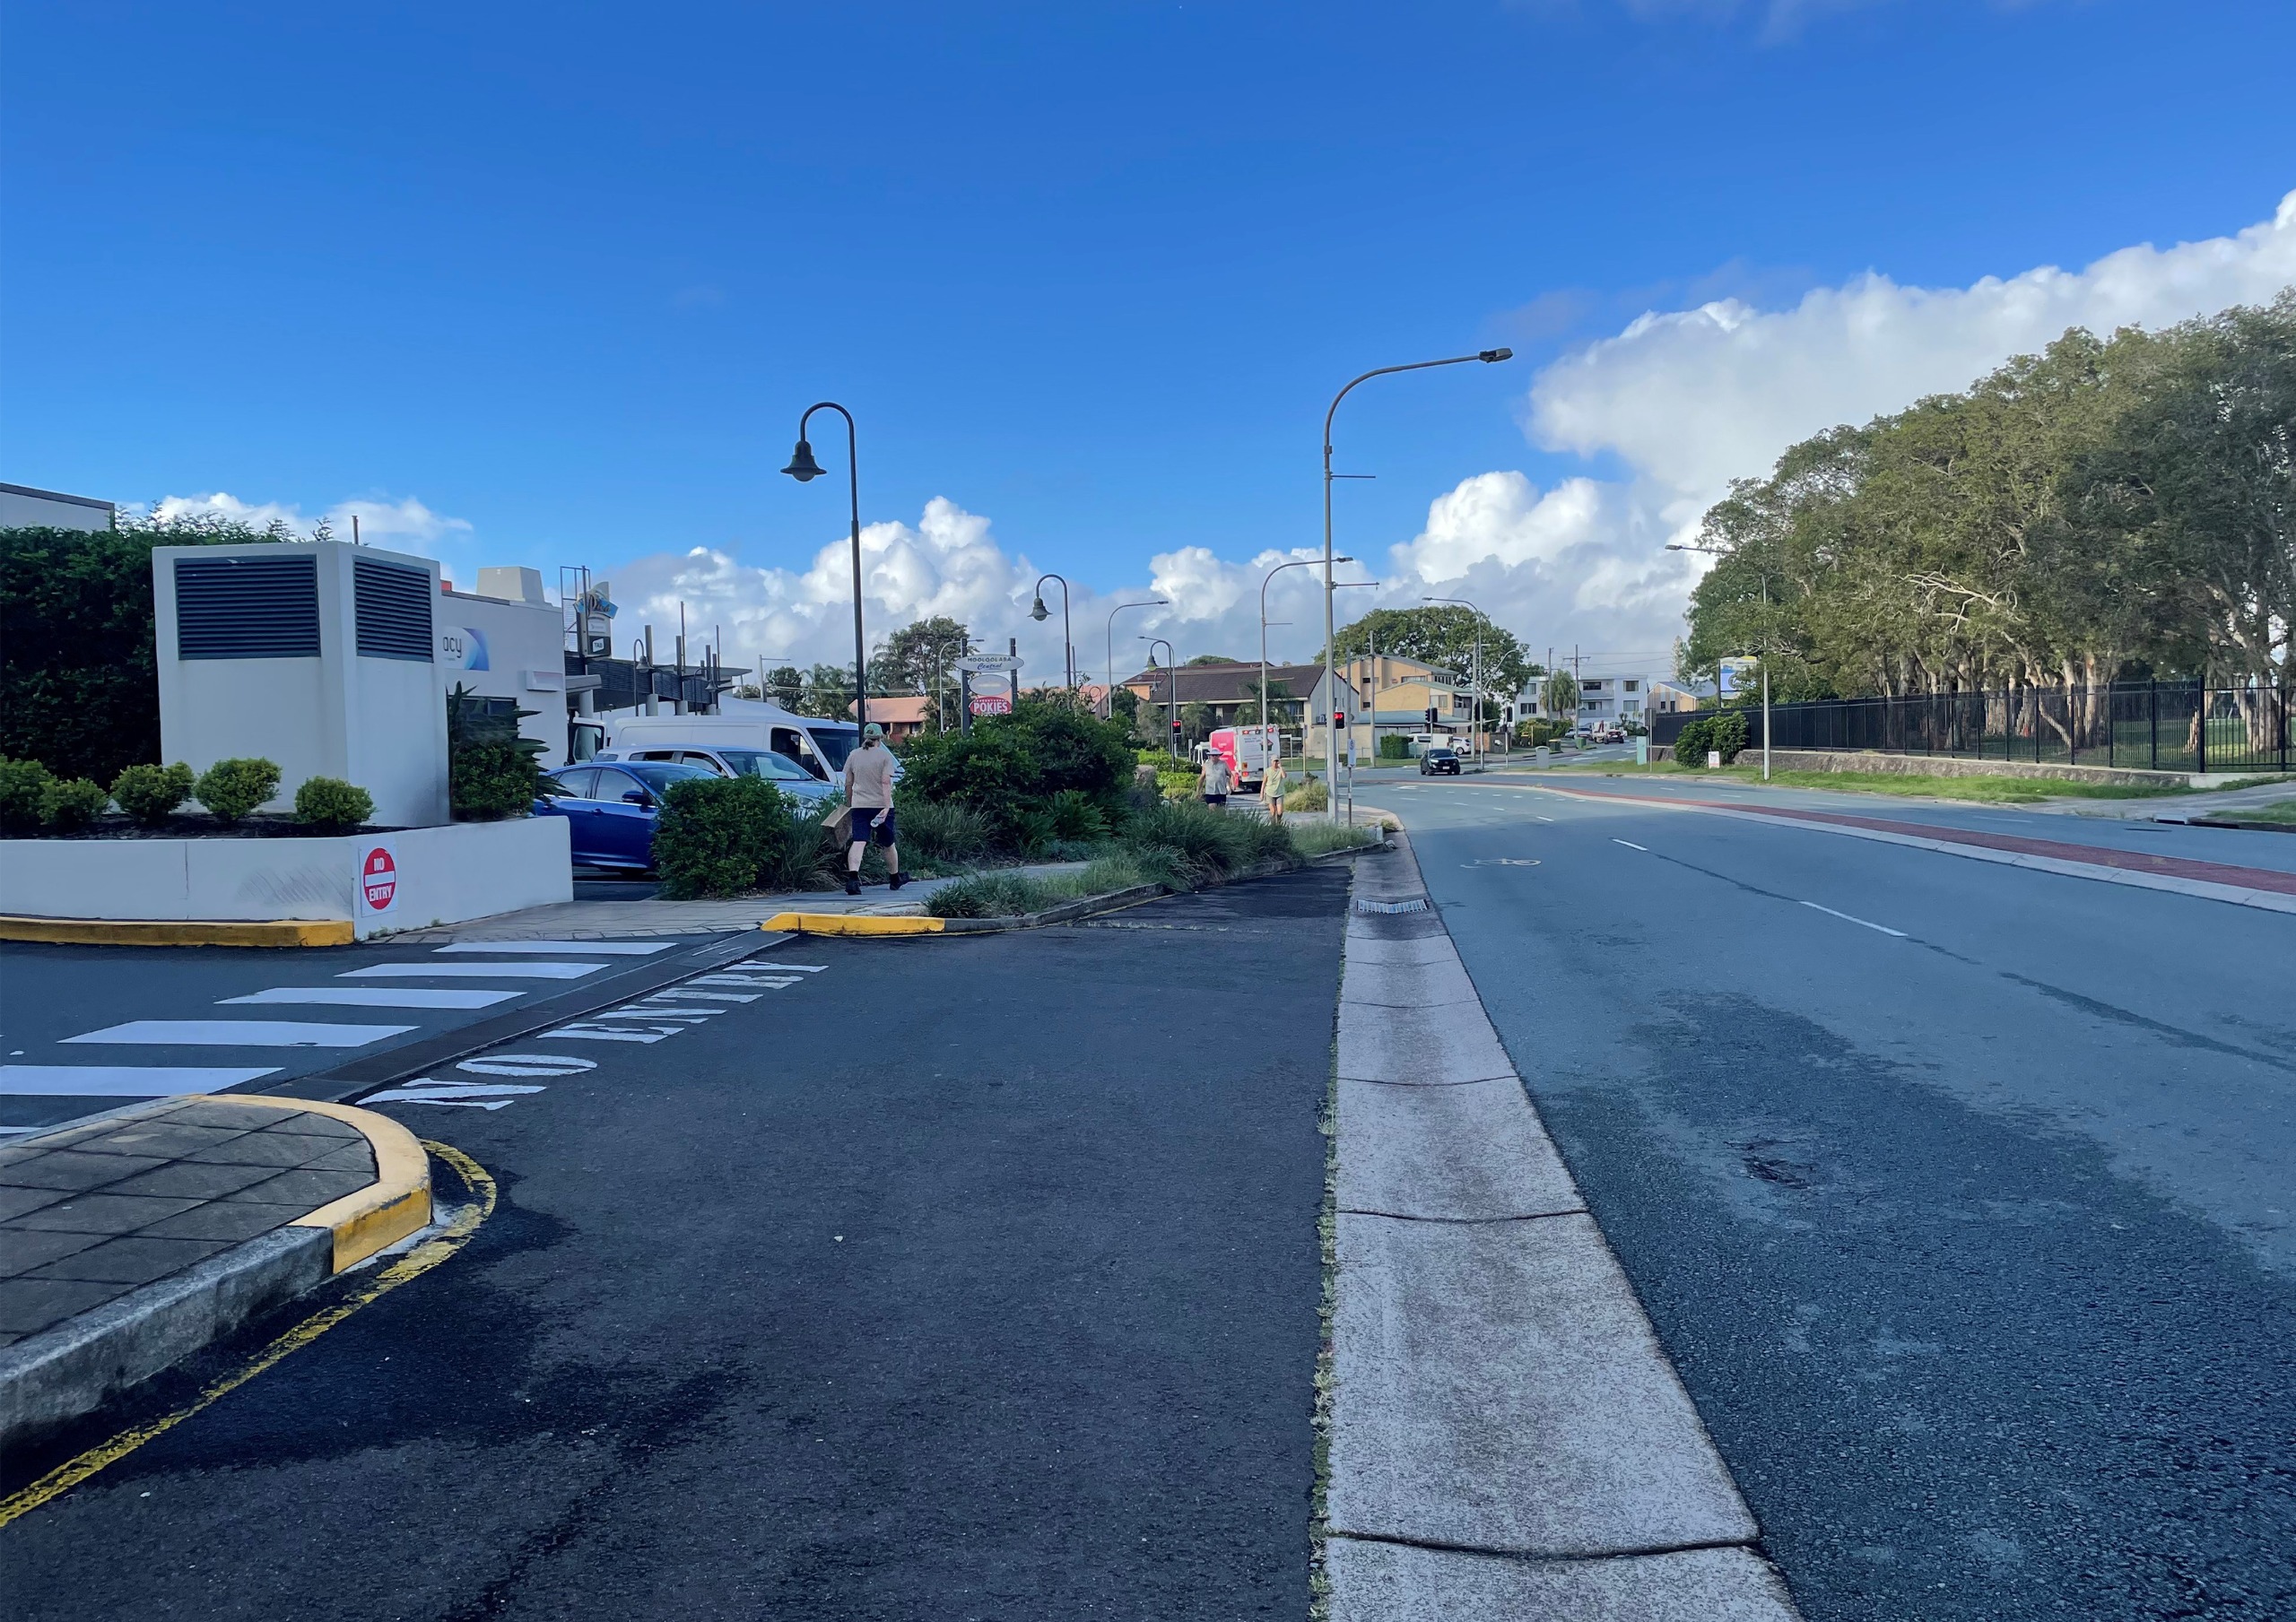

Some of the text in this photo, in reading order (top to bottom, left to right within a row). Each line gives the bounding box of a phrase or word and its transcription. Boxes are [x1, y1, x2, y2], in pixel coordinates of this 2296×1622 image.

[977, 663, 1003, 671] Central
[973, 701, 1008, 713] POKIES
[373, 857, 385, 872] NO
[369, 885, 392, 902] ENTRY
[355, 960, 830, 1111] NO ENTRY
